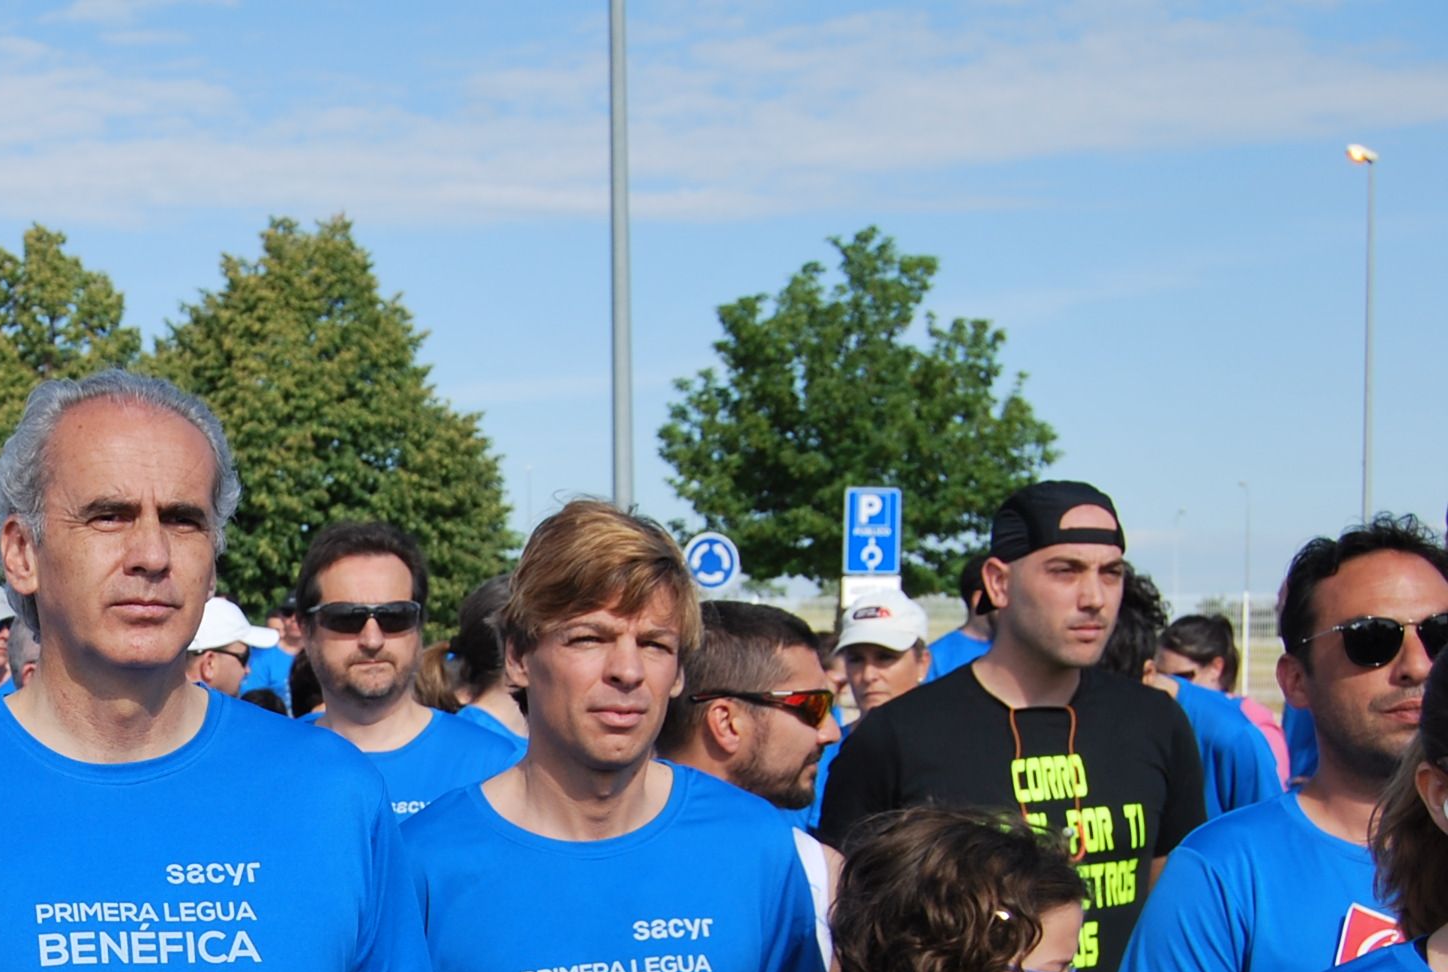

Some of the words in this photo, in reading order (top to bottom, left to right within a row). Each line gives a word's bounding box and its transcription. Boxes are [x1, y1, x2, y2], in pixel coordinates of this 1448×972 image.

[858, 494, 884, 525] P
[1011, 754, 1088, 803] CORRO
[1123, 803, 1146, 849] TI
[166, 862, 261, 886] sacyr
[35, 902, 159, 924] PRIMERA
[163, 901, 258, 922] LEGUA
[38, 923, 263, 967] BENÉFICA
[633, 918, 714, 941] sacyr
